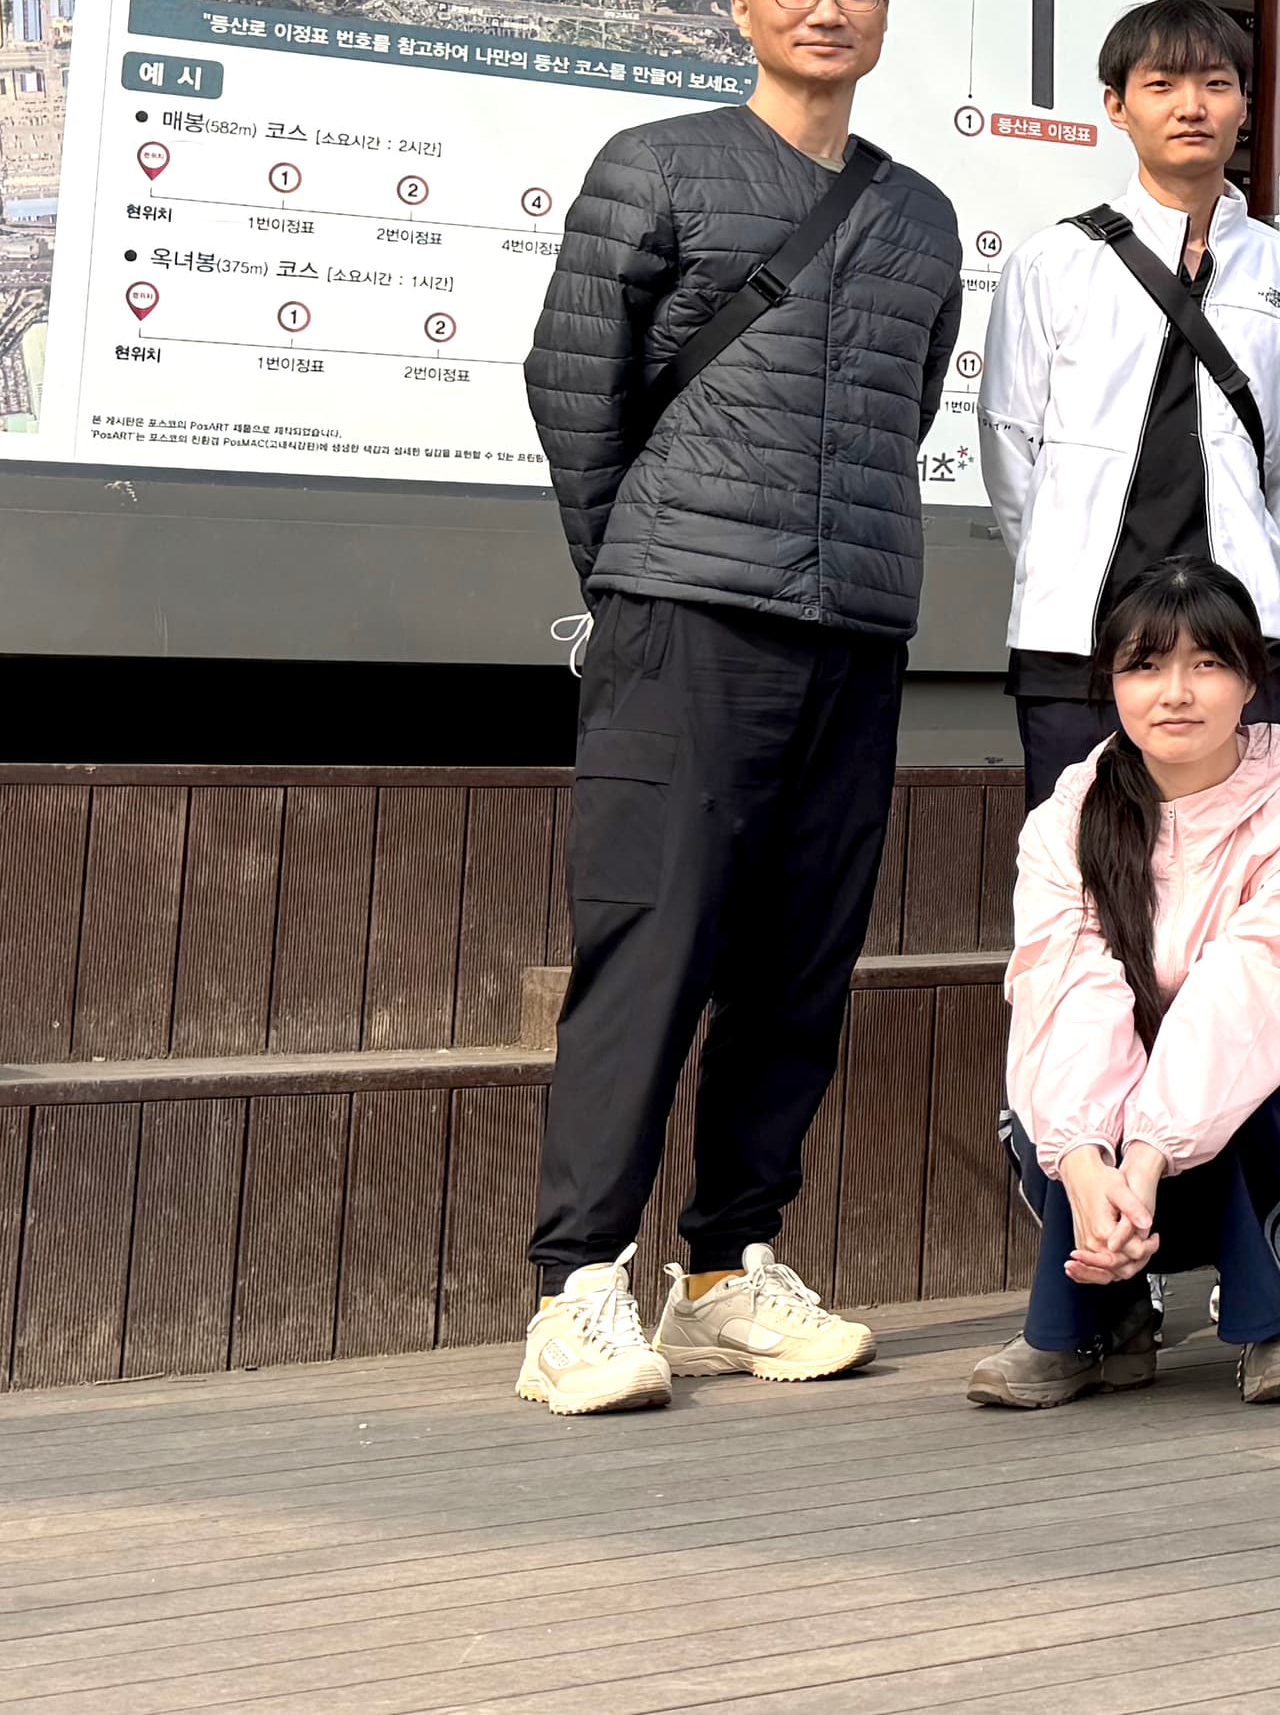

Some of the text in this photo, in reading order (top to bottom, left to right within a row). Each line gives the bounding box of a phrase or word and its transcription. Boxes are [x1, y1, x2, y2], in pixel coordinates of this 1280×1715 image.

[274, 22, 329, 45] 이정표
[336, 30, 390, 53] 번호를
[397, 37, 468, 62] 참고하여
[475, 48, 528, 69] 나만의
[534, 56, 570, 74] 등산
[574, 60, 627, 81] 코스를
[633, 67, 683, 88] 만들어
[162, 111, 257, 139] 매봉(582m)
[265, 121, 308, 141] 코스
[316, 130, 380, 150] [소요시간
[398, 139, 442, 158] 2시간]
[965, 114, 973, 129] 1
[997, 117, 1091, 143] 등산로 이정표
[282, 171, 541, 208] 1 2 4
[126, 204, 172, 223] 현위치
[248, 216, 315, 234] 1번이정표
[376, 227, 443, 245] 2번이정표
[982, 237, 996, 251] 14
[150, 247, 268, 278] 옥녀봉(375m)
[276, 260, 319, 280] 코스
[327, 267, 392, 287] [소요시간
[412, 275, 454, 293] 1시간]
[290, 309, 446, 335] 1 2
[115, 344, 470, 383] 현위치 1번이정표 2번이정표
[962, 359, 976, 372] 11
[190, 421, 230, 432] PosART
